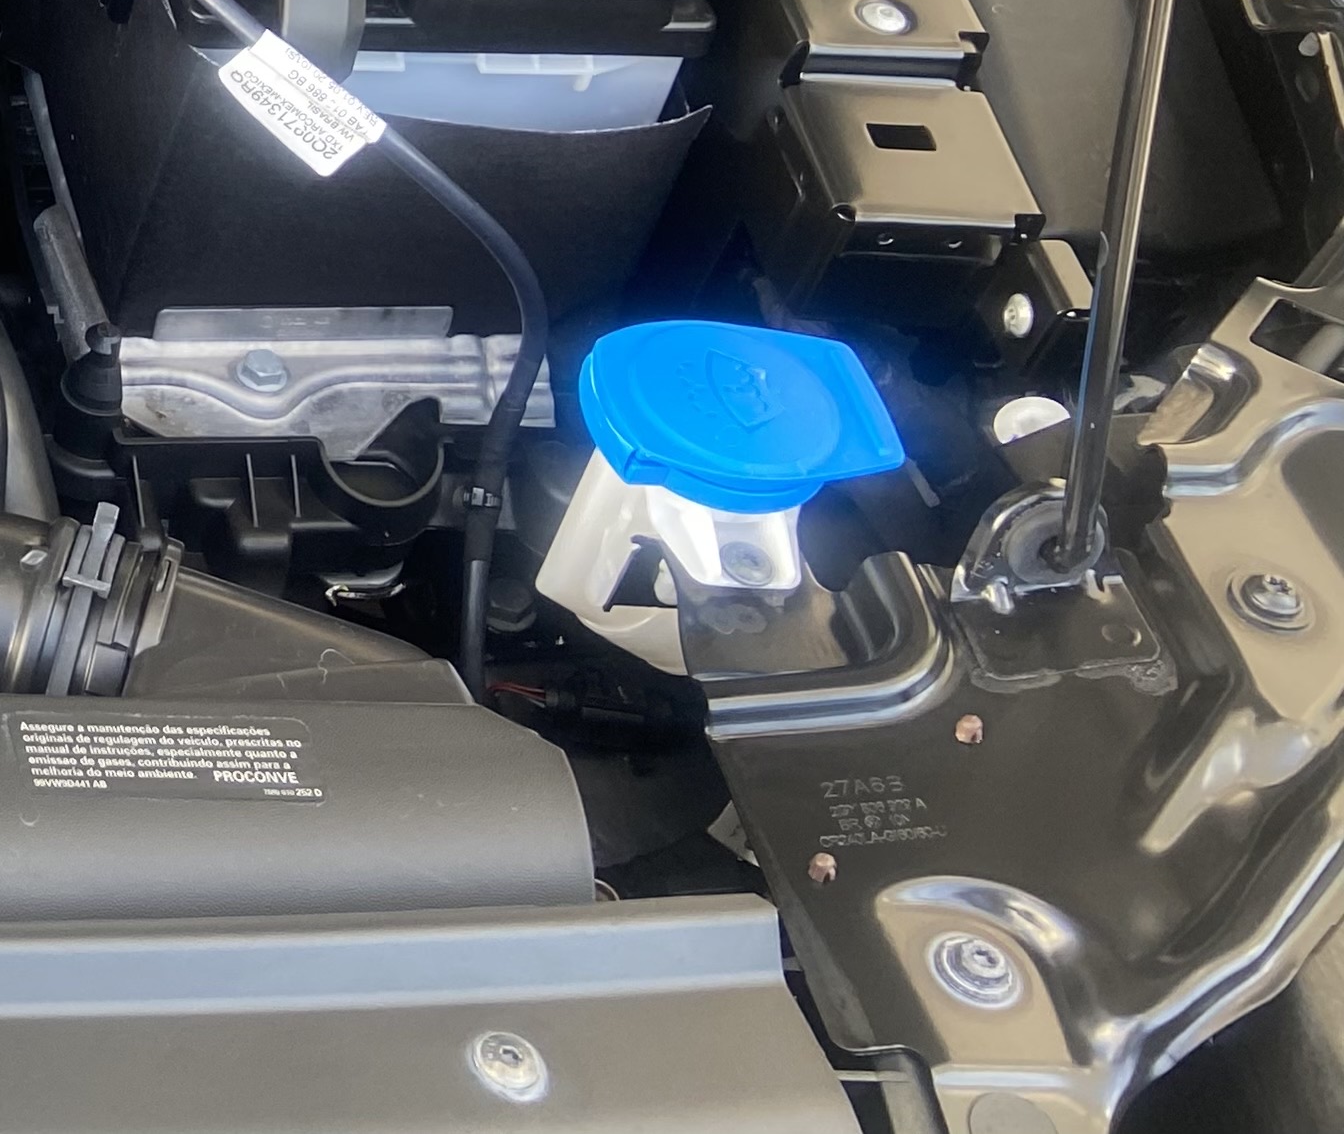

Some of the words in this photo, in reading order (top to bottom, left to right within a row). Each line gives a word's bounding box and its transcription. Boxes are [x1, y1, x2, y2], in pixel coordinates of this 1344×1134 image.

[307, 101, 338, 128] BRASIL
[20, 721, 74, 733] Assegure
[87, 724, 159, 735] manutenção
[163, 725, 183, 734] das
[23, 733, 73, 744] originais
[76, 734, 91, 743] de
[93, 735, 156, 746] regulagem
[159, 736, 174, 745] do
[225, 738, 283, 748] prescritas
[285, 740, 302, 748] no
[25, 744, 69, 754] manual
[72, 745, 87, 754] de
[157, 747, 242, 758] especialmente
[244, 749, 287, 760] quanto
[289, 751, 297, 759] a
[80, 756, 95, 765] de
[137, 757, 213, 768] contribuindo
[216, 759, 251, 769] assim
[253, 761, 280, 770] para
[283, 762, 291, 770] a
[31, 766, 83, 776] melhoria
[87, 767, 102, 777] do
[105, 768, 135, 777] meio
[213, 770, 299, 784] PROCONVE
